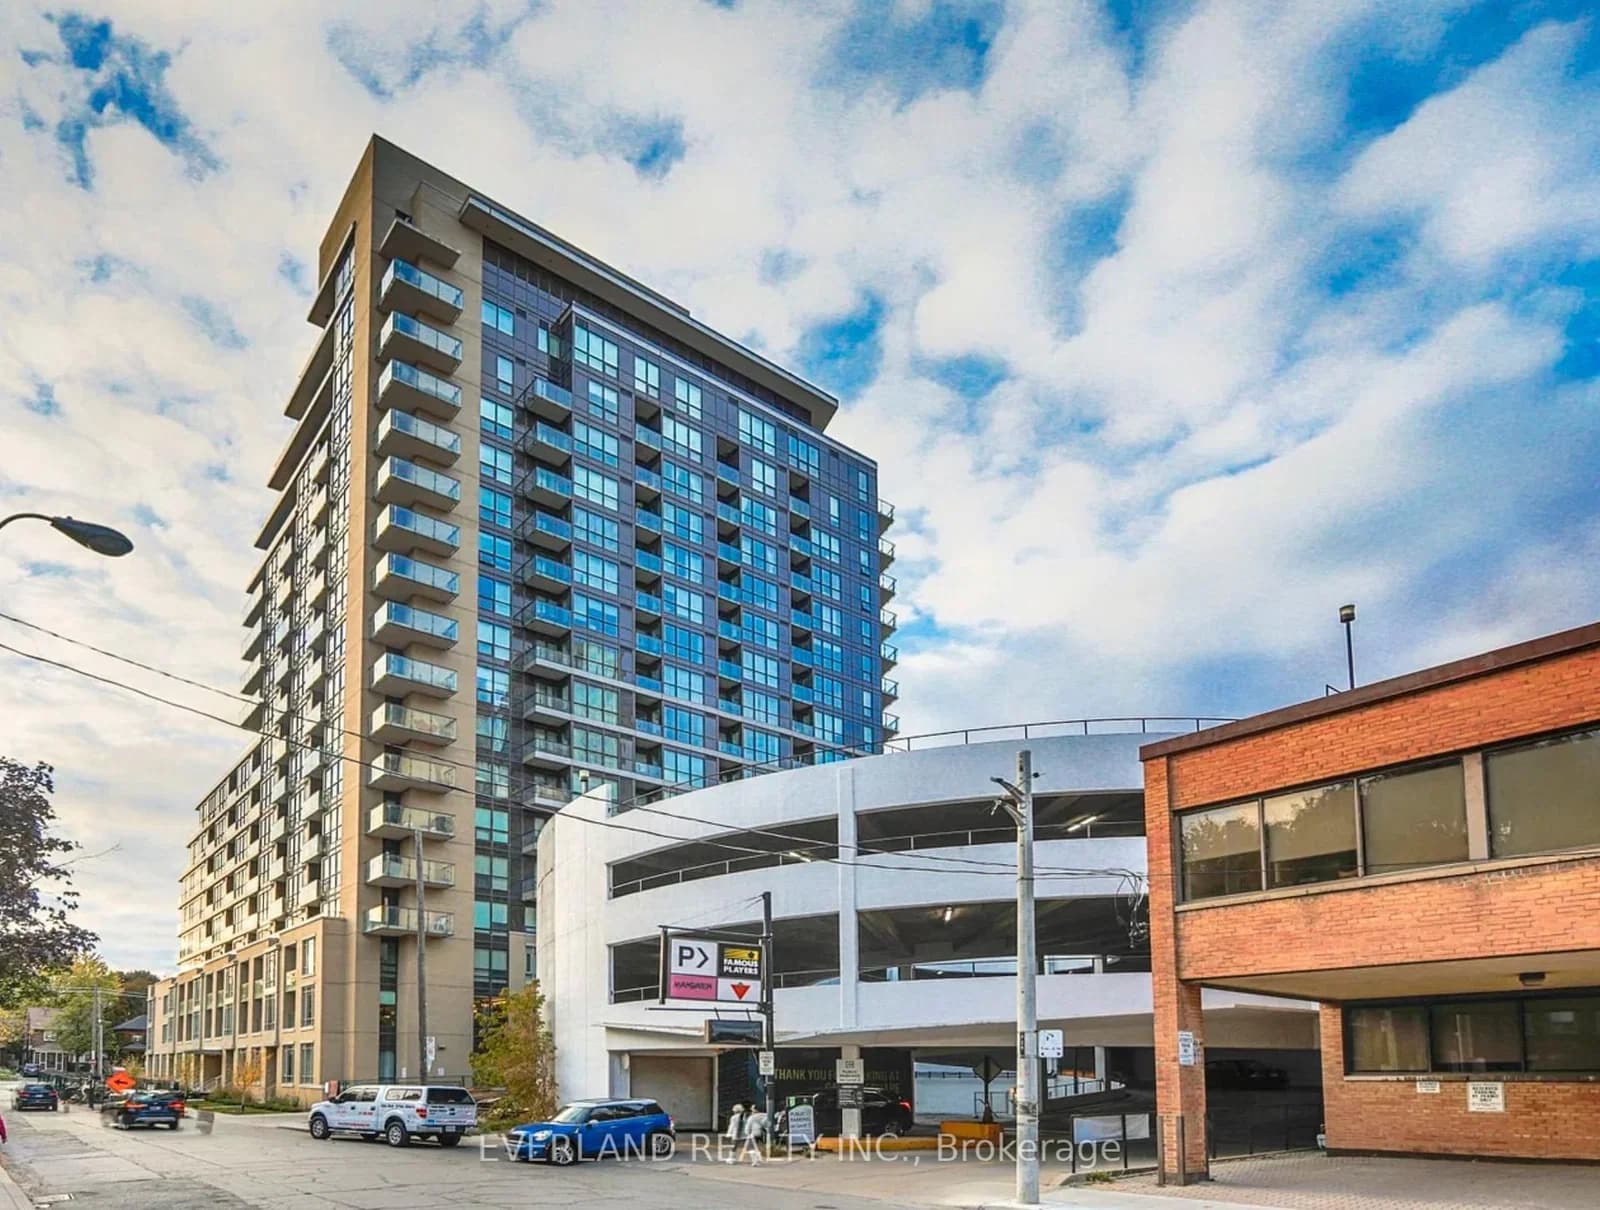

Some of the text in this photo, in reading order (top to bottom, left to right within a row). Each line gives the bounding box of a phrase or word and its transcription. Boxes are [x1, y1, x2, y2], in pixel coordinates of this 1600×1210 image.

[723, 958, 759, 967] FAMOUS
[723, 966, 758, 975] PLAYERS
[774, 1068, 806, 1080] THANK
[808, 1069, 826, 1080] YOU
